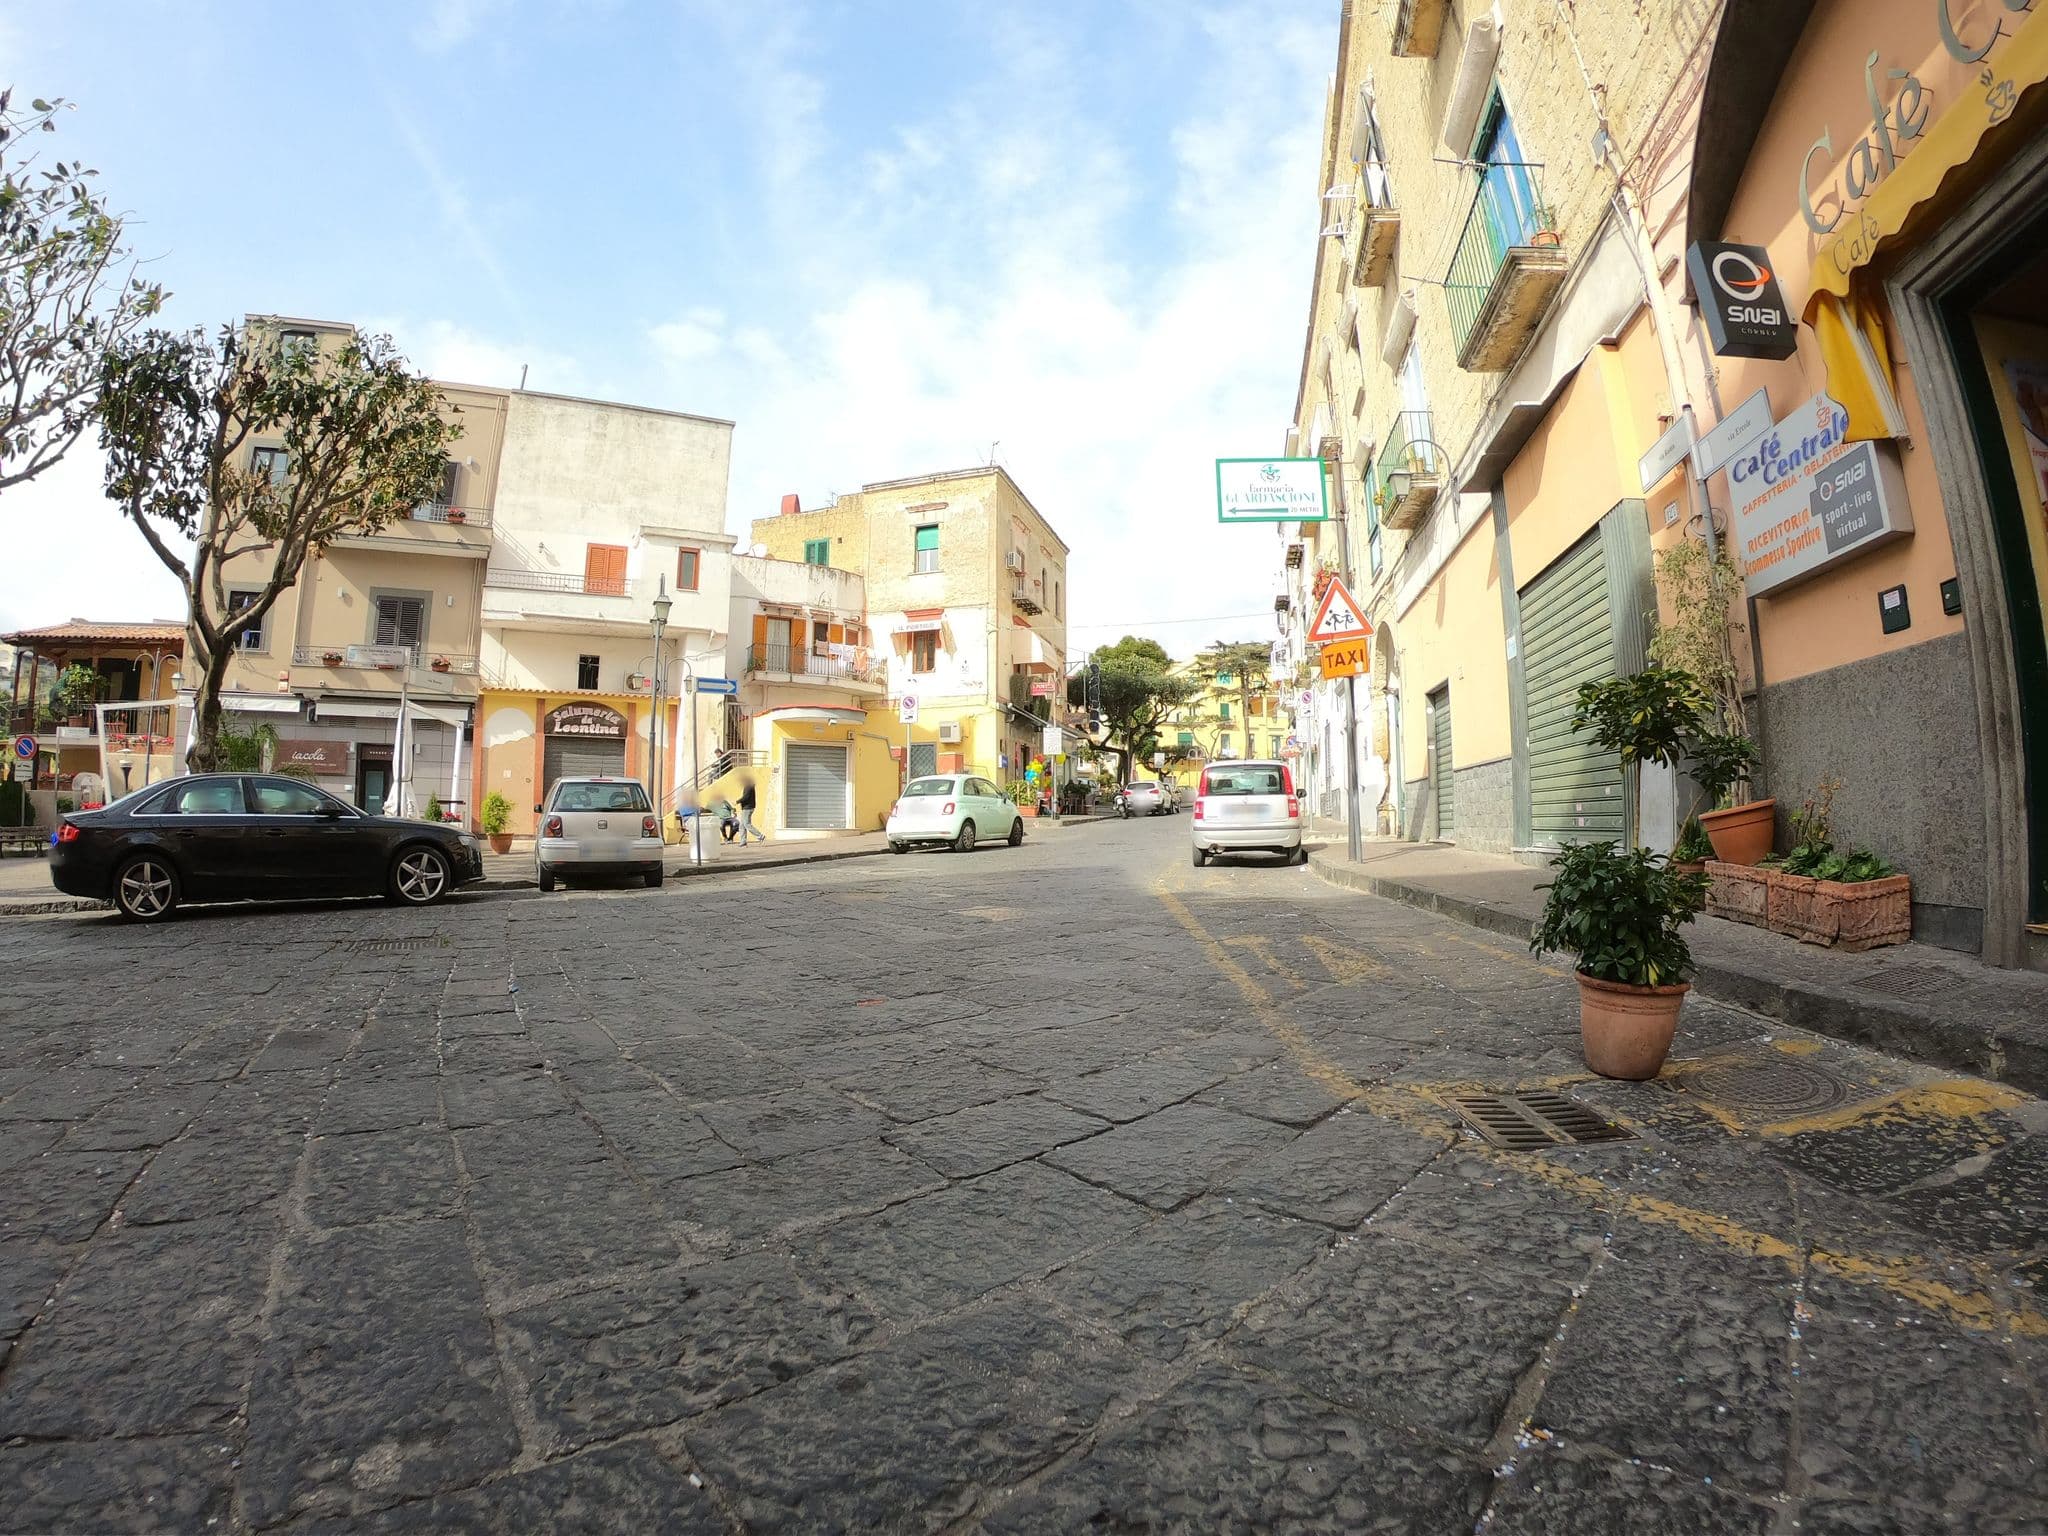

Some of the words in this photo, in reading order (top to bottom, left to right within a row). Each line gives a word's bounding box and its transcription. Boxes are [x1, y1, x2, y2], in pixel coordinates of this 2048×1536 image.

[1732, 431, 1781, 483] Café
[1763, 411, 1849, 485] Centrale
[1742, 474, 1798, 515] CAFFETTERIA
[1825, 501, 1849, 525] sport
[1854, 489, 1873, 508] live
[1747, 507, 1811, 553] RICEVITORIA
[1786, 525, 1822, 559] Sportive
[1835, 512, 1867, 539] virtual
[1325, 648, 1364, 669] TAXI
[552, 706, 621, 725] Salumeria
[553, 721, 620, 735] Leontina
[581, 715, 593, 724] da
